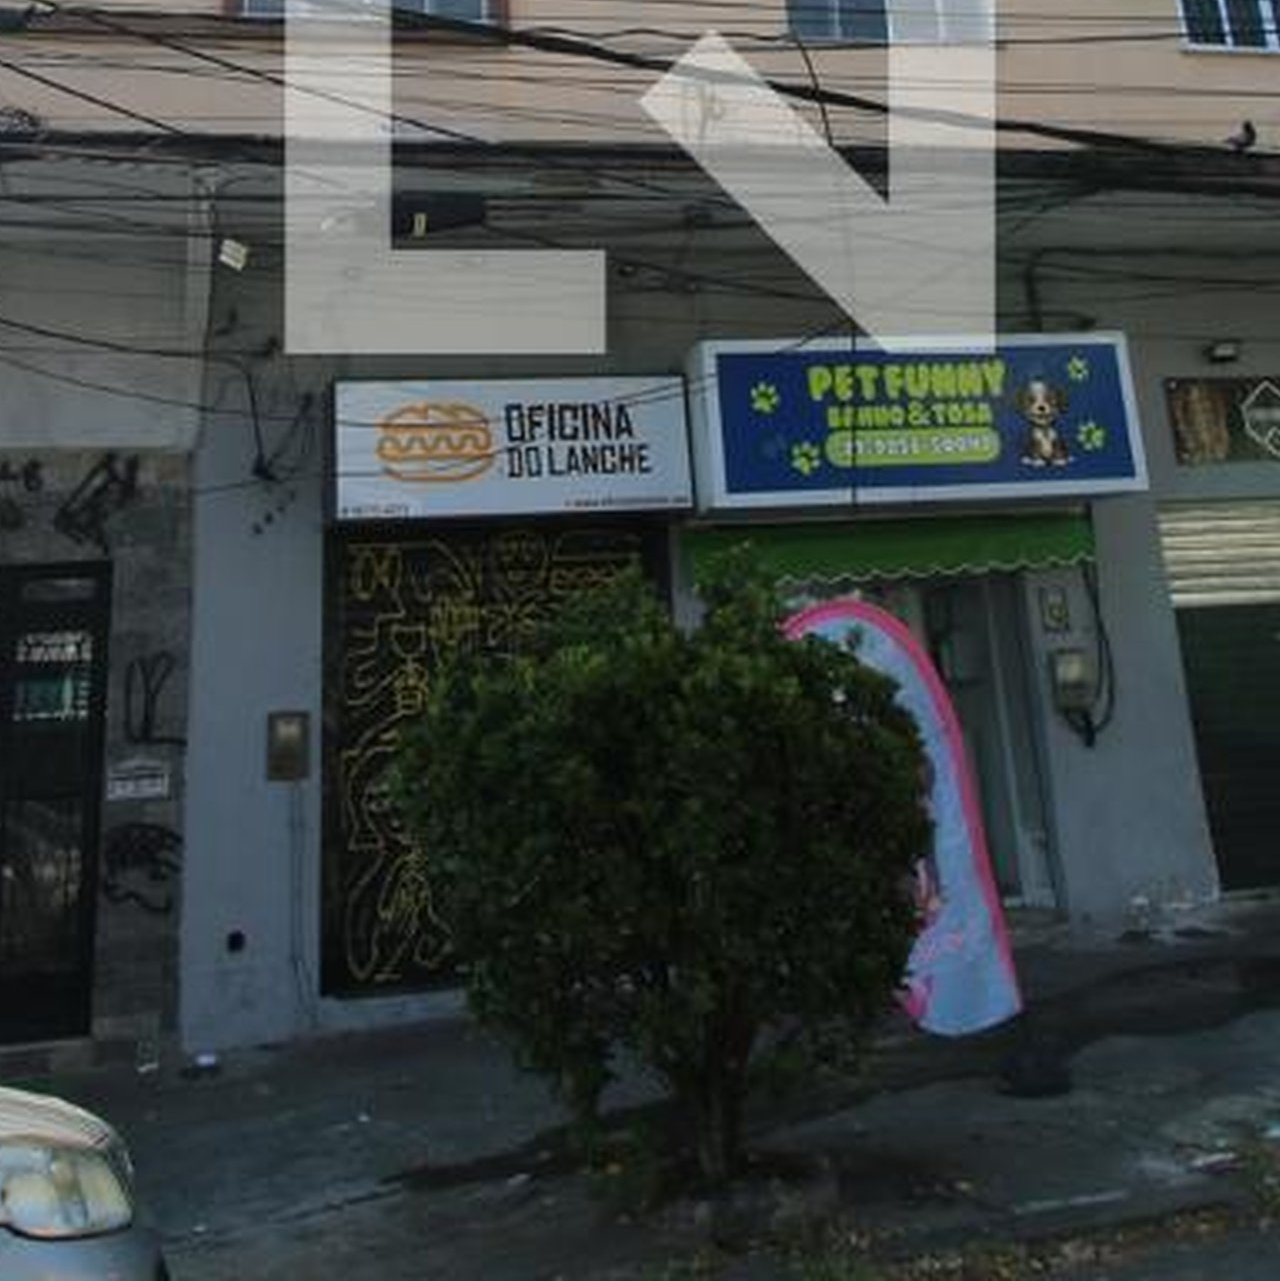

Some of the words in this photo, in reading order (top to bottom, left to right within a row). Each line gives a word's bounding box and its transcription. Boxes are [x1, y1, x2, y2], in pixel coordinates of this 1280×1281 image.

[808, 364, 878, 401] PET
[884, 359, 1005, 399] FUNNY
[505, 403, 634, 442] OFICINA
[908, 401, 930, 425] &
[507, 447, 543, 479] DO
[547, 444, 653, 476] LANCHE
